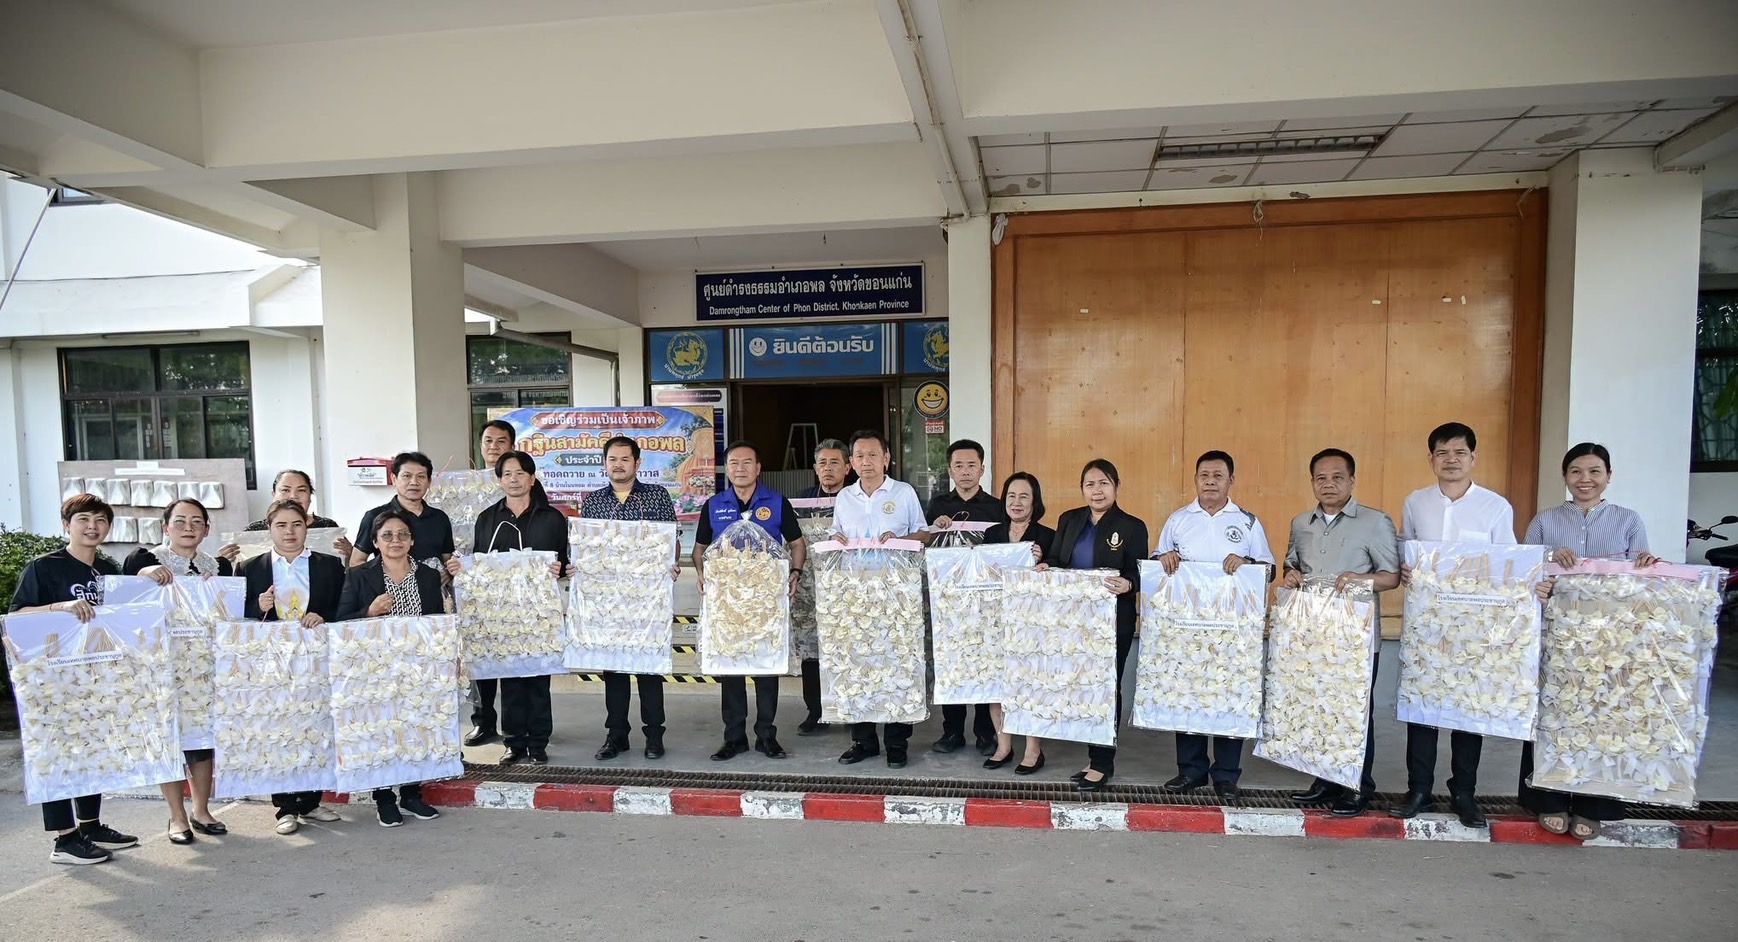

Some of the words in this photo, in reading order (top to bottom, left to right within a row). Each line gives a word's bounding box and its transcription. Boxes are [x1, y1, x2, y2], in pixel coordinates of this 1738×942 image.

[703, 275, 826, 301] ศูนย์ดำรงธรรมอำเภอพล
[829, 272, 912, 293] จังหวัดขอนแก่น
[709, 305, 757, 316] Damrongtham
[757, 303, 781, 314] Center
[783, 303, 790, 313] of
[793, 302, 811, 312] Phon
[842, 300, 877, 311] Khonkaen
[879, 299, 910, 309] Province
[773, 335, 874, 354] ยินดีต้อนรับ
[541, 412, 656, 426] ขอเชิญร่วมเป็นเจ้าภาพ
[565, 454, 602, 464] ประจำปี
